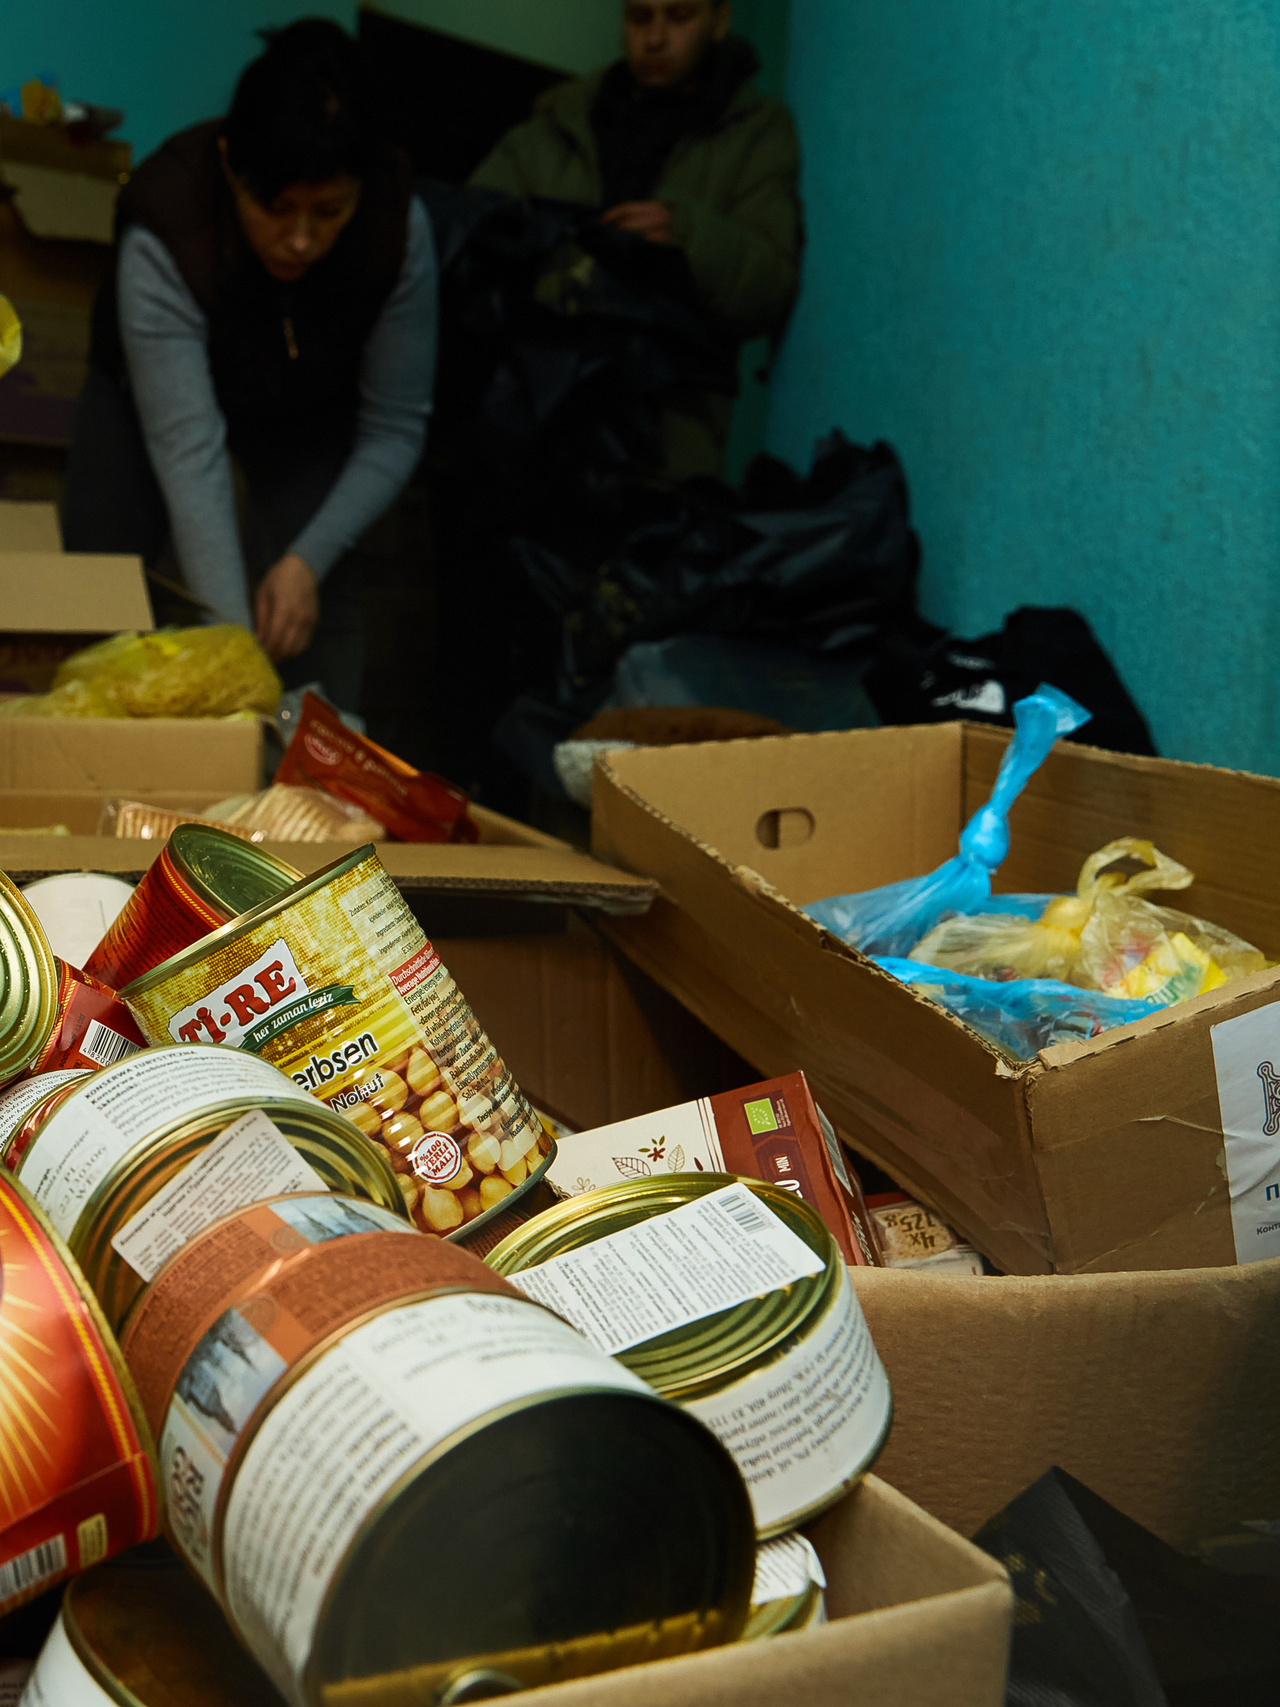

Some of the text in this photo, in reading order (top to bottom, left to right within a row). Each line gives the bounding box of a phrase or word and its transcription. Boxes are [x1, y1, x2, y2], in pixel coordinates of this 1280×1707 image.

[398, 975, 418, 994] Average
[253, 991, 334, 1043] her zaman leziz
[85, 1068, 132, 1100] KONSERWA
[331, 1072, 385, 1113] Nohut
[420, 1140, 441, 1162] %100
[431, 1150, 455, 1176] MALI
[774, 1155, 792, 1174] MIN
